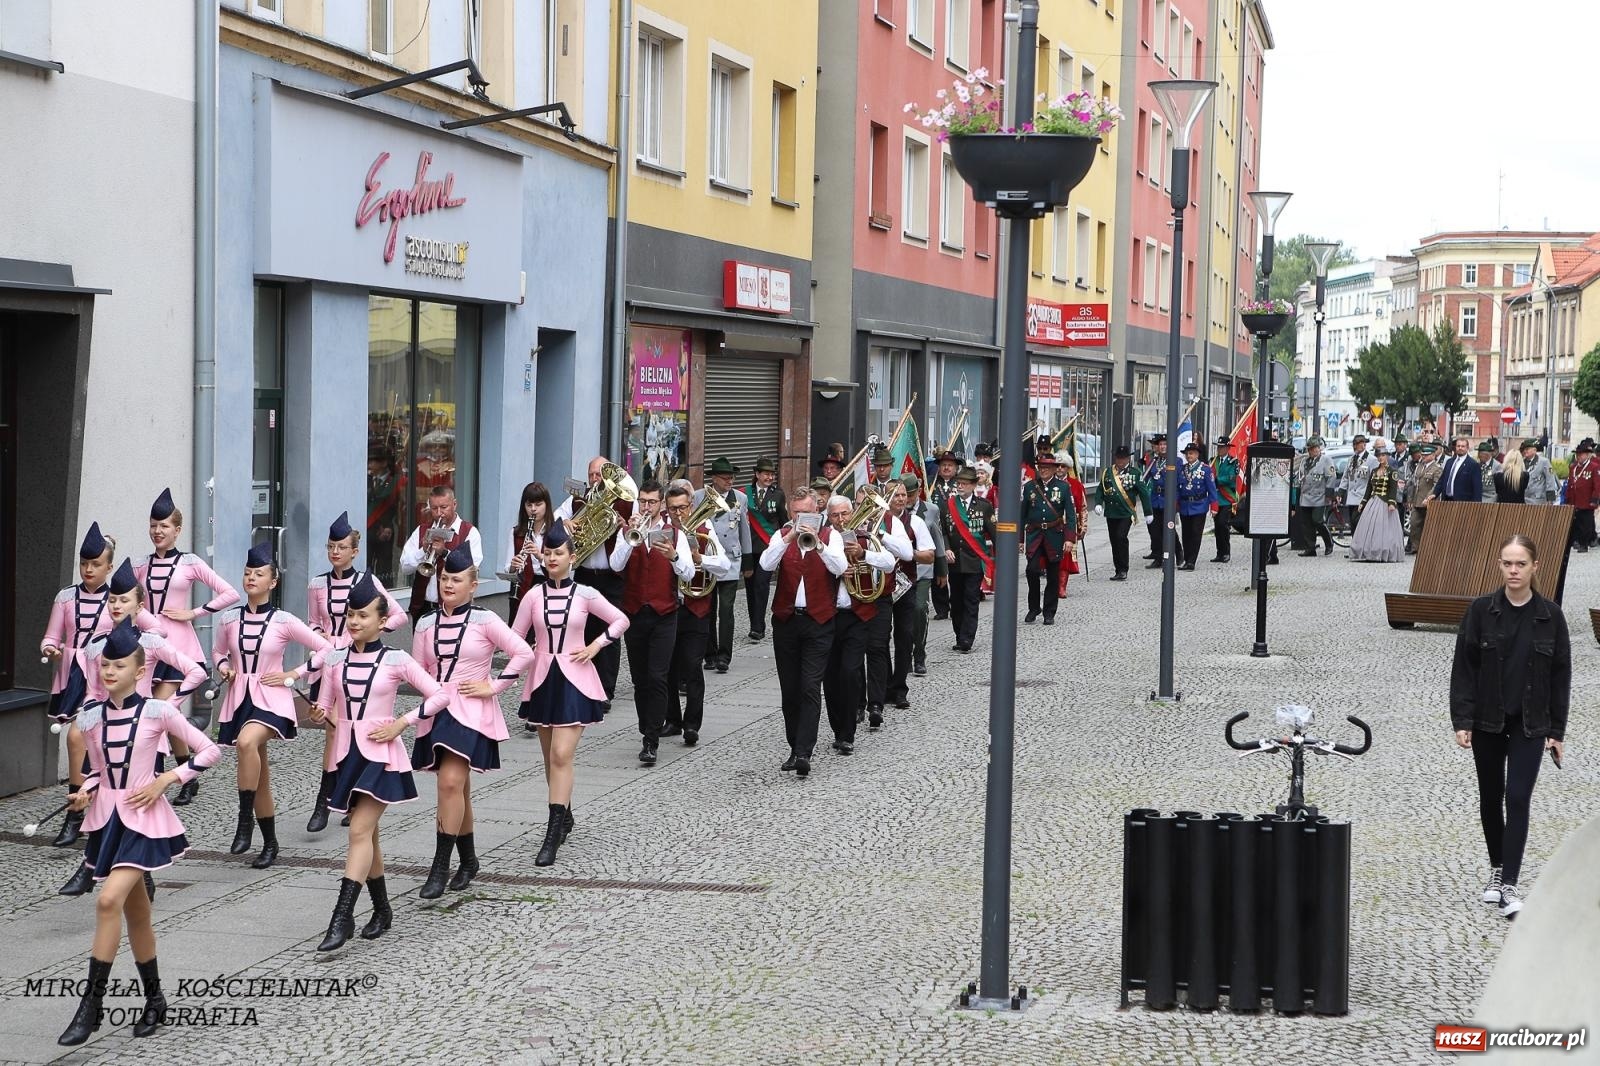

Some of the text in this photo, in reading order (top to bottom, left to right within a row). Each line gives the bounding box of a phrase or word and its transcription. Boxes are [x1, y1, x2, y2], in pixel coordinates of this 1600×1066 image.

[406, 235, 460, 263] ascomsun
[1079, 306, 1092, 316] as
[640, 366, 673, 383] BIELIZNA
[640, 386, 673, 396] Damska Męska
